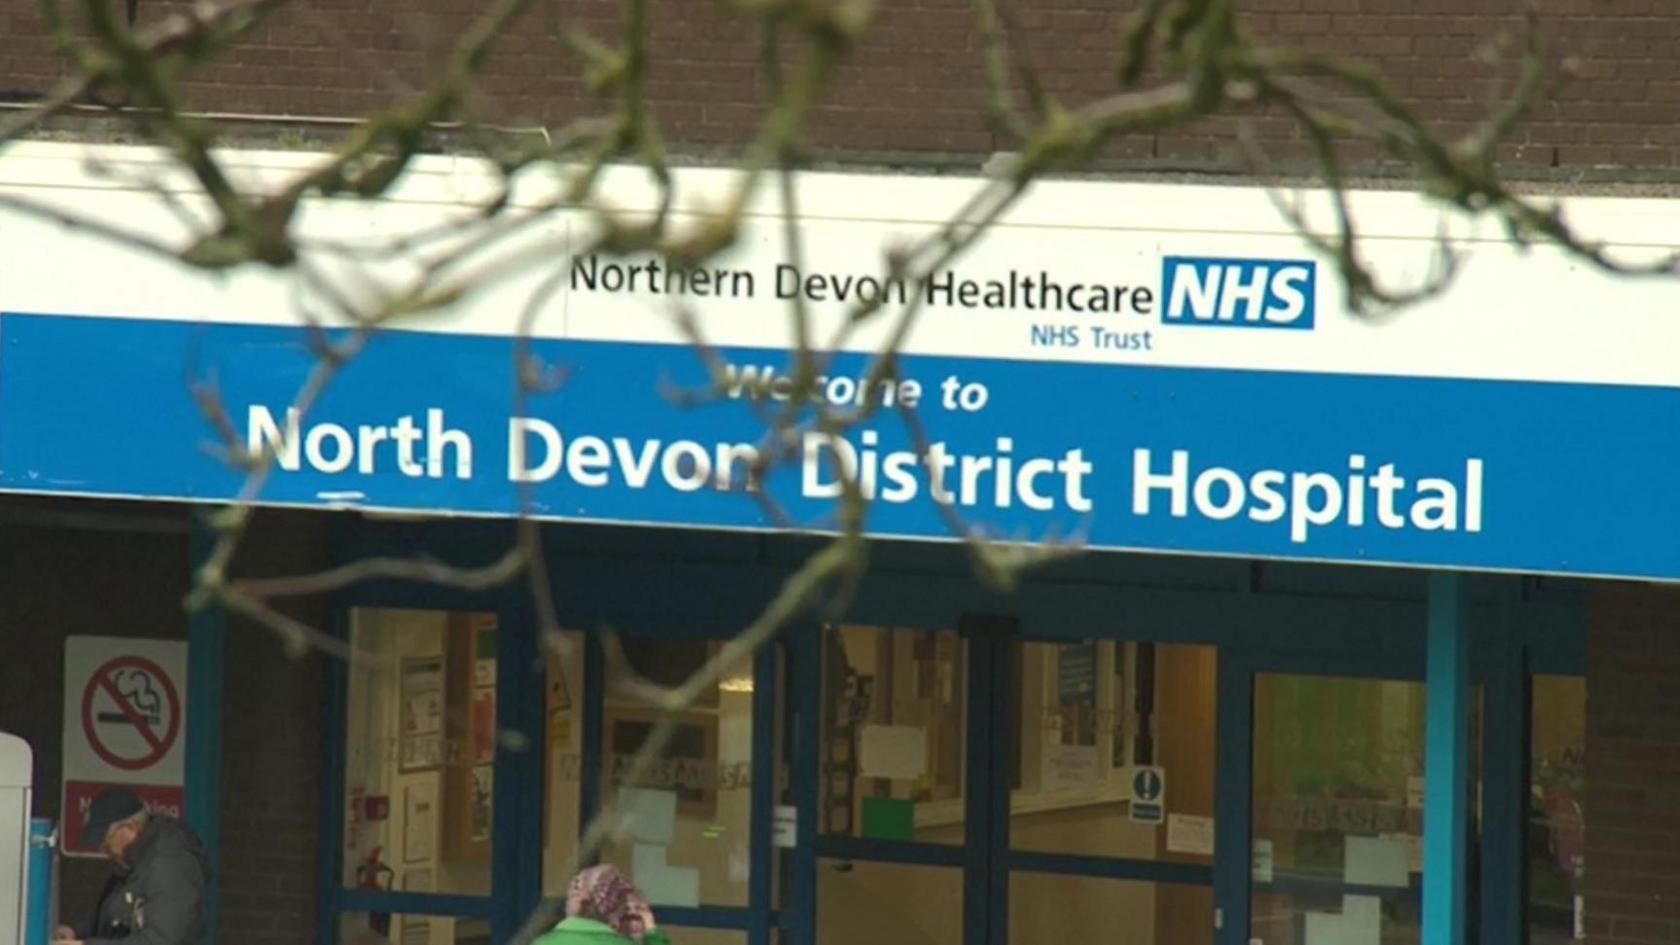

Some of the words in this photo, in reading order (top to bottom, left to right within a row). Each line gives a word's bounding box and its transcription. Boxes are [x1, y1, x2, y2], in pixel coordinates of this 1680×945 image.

[571, 254, 755, 298] Northern
[775, 264, 906, 304] Devon
[926, 270, 1153, 314] Healthcare
[1167, 263, 1309, 323] NHS
[1030, 325, 1079, 347] NHS
[1091, 327, 1152, 350] Trust
[725, 364, 922, 408] Weome
[941, 375, 989, 412] to
[249, 405, 472, 479] North
[508, 417, 760, 492] Devon
[802, 430, 1092, 512] District
[1132, 448, 1483, 542] Hospital
